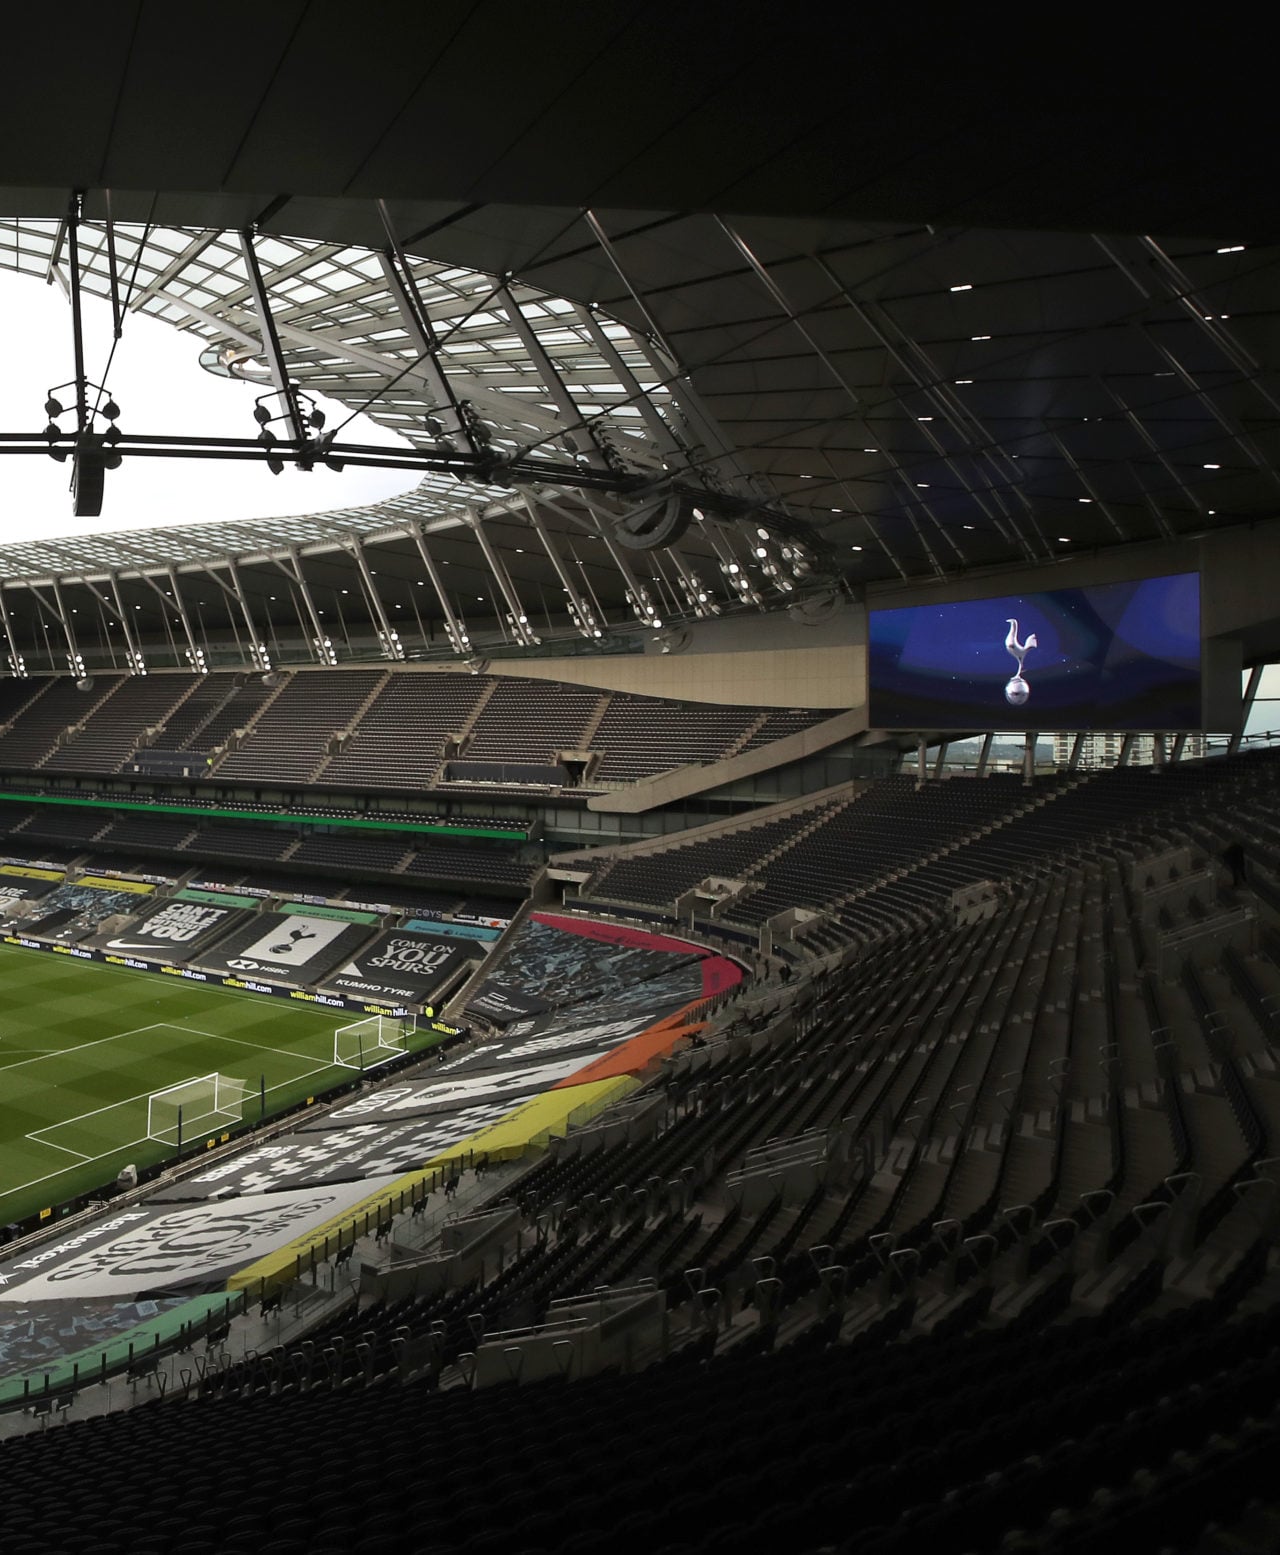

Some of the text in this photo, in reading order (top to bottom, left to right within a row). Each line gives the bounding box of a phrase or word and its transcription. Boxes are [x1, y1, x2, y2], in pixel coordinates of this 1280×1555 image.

[154, 911, 218, 926] SMILE
[166, 903, 229, 918] CAN'T
[136, 922, 200, 941] YOU
[147, 918, 211, 931] WITHOUT
[52, 945, 92, 959] williamhill.com
[390, 939, 457, 954] COME ON
[105, 955, 148, 970] williamhill.com
[383, 944, 450, 966] YOU
[160, 965, 207, 981] williamhill.com
[259, 965, 291, 976] HSBC
[367, 957, 438, 975] SPURS
[222, 977, 272, 994] williamhill.com
[336, 979, 415, 998] KUMHO TYRE
[289, 989, 344, 1008] williamhill.com
[108, 1203, 294, 1275] YOU
